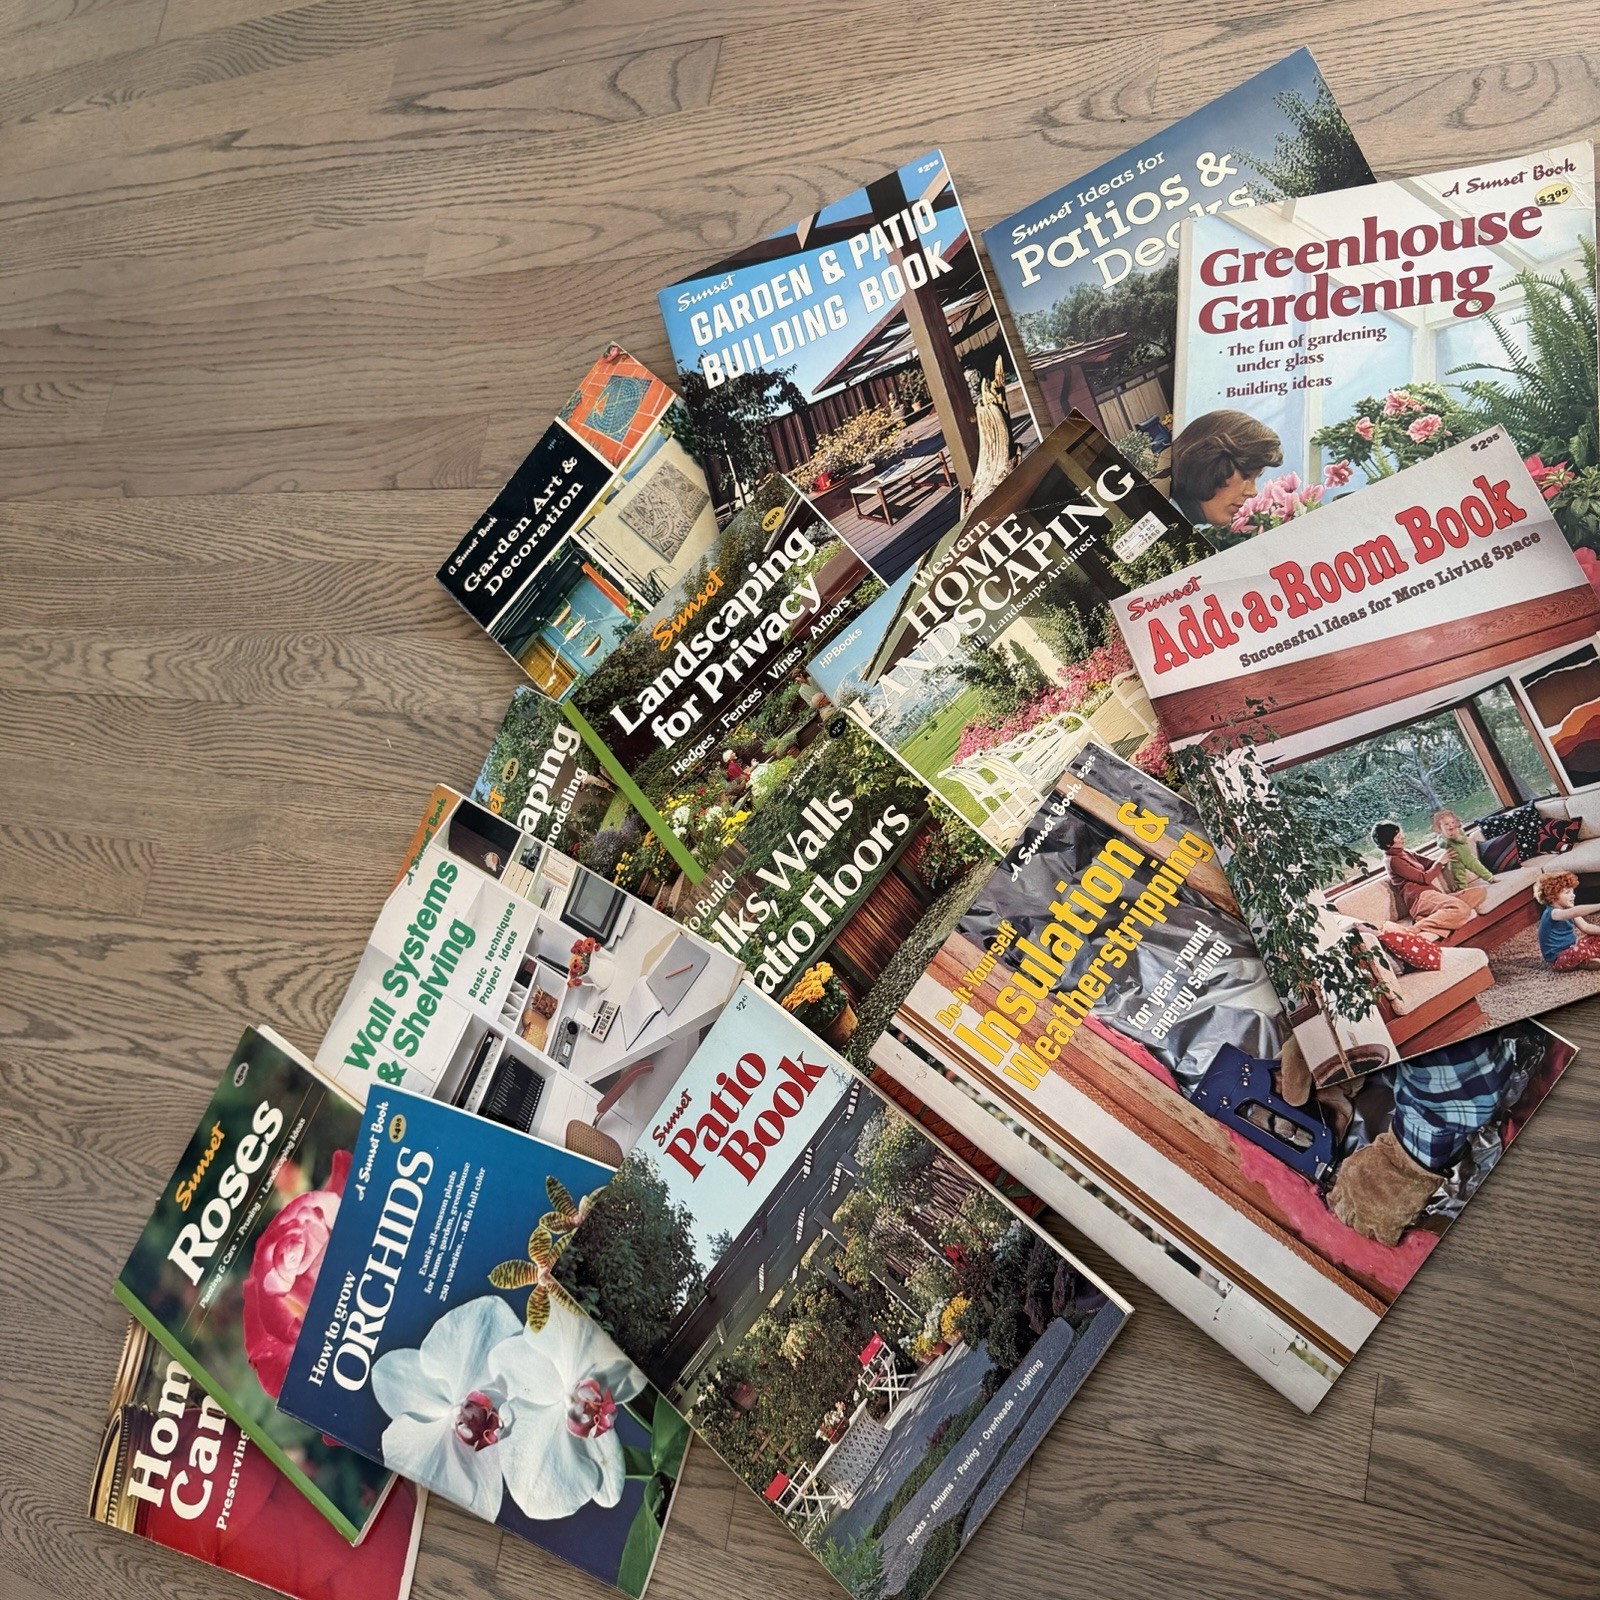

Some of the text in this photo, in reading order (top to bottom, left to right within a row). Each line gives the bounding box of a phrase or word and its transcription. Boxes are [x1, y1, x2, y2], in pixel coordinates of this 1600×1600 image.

[1010, 152, 1238, 288] Patios &
[1011, 152, 1165, 245] Sunset Ideas for
[1442, 158, 1576, 197] A Sunset Book
[677, 273, 736, 313] Sunset
[689, 198, 938, 347] GARDEN & PATIO
[1198, 261, 1496, 334] Gardening
[1200, 206, 1543, 287] Greenhouse
[699, 240, 953, 390] BUILDING BOOK
[1228, 325, 1388, 357] The fun of gardening
[1236, 353, 1325, 373] under glass
[1226, 374, 1333, 398] Building ideas
[455, 536, 480, 568] Sunset
[478, 516, 498, 538] Book
[463, 456, 579, 592] Garden Art &
[484, 481, 584, 597] Decoration
[910, 520, 992, 590] Western
[1395, 475, 1527, 564] Book
[652, 566, 726, 652] Sunset
[845, 464, 1136, 726] LANDSCAPING
[901, 513, 1033, 639] HOME
[989, 581, 1047, 634] Landscape
[1046, 533, 1098, 584] Architect
[1127, 575, 1202, 622] Sunset
[1238, 530, 1542, 668] Successful Ideas for More Living Space
[610, 527, 817, 736] Landscaping
[650, 572, 823, 750] for Privacy
[818, 627, 863, 669] HPBooks
[671, 596, 852, 777] Hedges Fences Vines Arbors
[793, 757, 815, 786] Sunset
[813, 740, 832, 759] Book
[411, 827, 432, 870] Sunset
[428, 799, 446, 827] Book
[711, 790, 854, 955] lks, Walls
[1011, 781, 1082, 882] A Sunset Book
[468, 902, 516, 998] Basic techniques
[683, 870, 737, 930] o Build
[745, 804, 911, 994] atio Floors
[953, 802, 1170, 1067] Insulation &
[343, 861, 458, 1071] Wall Systems
[377, 918, 476, 1087] & Shelving
[479, 965, 503, 1006] Project
[934, 920, 1017, 1030] Do-It-Yourself
[1003, 831, 1214, 1092] Weatherstripping
[1127, 920, 1213, 1031] for year-round
[1151, 937, 1232, 1041] energy saving
[175, 1120, 225, 1213] Sunset
[358, 1100, 390, 1202] A Sunset Book
[652, 1088, 692, 1147] Sunset
[663, 1052, 767, 1184] Patio
[717, 1050, 829, 1187] Book
[167, 1100, 284, 1287] Roses
[200, 1118, 306, 1309] Planting & Care Pruning Landscaping Ideas
[418, 1170, 457, 1276] Exotic all-season plants
[424, 1162, 470, 1294] for home, garden, greenhouse
[464, 1209, 474, 1220] in
[467, 1191, 479, 1209] full
[474, 1167, 486, 1191] color
[332, 1146, 434, 1392] ORCHIDS
[439, 1284, 450, 1302] 250
[308, 1270, 357, 1387] How to grow
[906, 1358, 1044, 1546] Decks Atriums Paving Overheads Lighting
